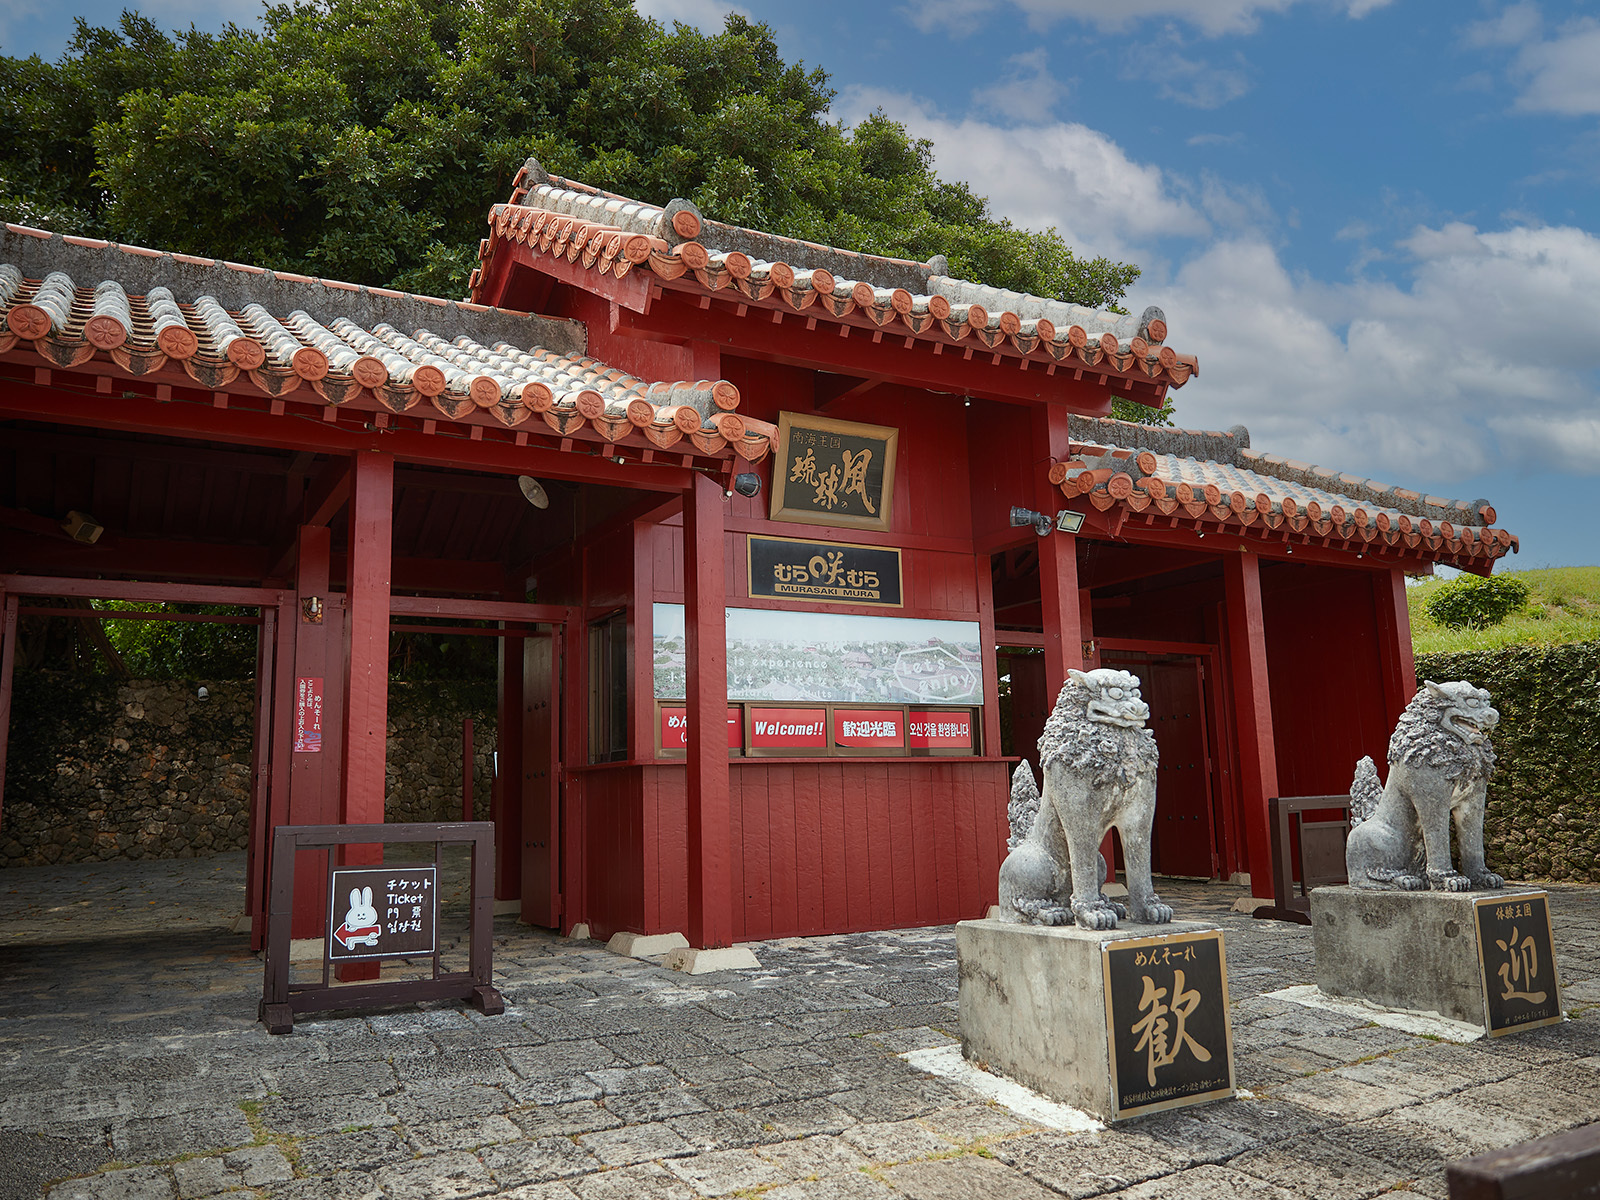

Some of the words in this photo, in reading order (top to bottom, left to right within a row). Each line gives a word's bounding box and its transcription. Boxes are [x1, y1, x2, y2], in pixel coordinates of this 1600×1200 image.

[792, 431, 841, 449] 南海王国
[780, 585, 838, 596] MURASAKI
[843, 589, 874, 598] MURA
[734, 657, 745, 667] is
[752, 657, 828, 670] experience
[902, 654, 946, 675] Let's
[314, 695, 322, 730] めんそーれ
[755, 721, 824, 736] Welcome!!
[910, 722, 923, 737] 오신
[924, 722, 937, 737] 것을
[938, 722, 969, 738] 환영합니다
[386, 878, 432, 890] チケット
[386, 893, 424, 905] Ticket
[1495, 902, 1532, 920] 体験王国
[387, 919, 422, 934] 입장권
[1134, 945, 1197, 967] めんそーれ
[1495, 926, 1547, 1004] 迎
